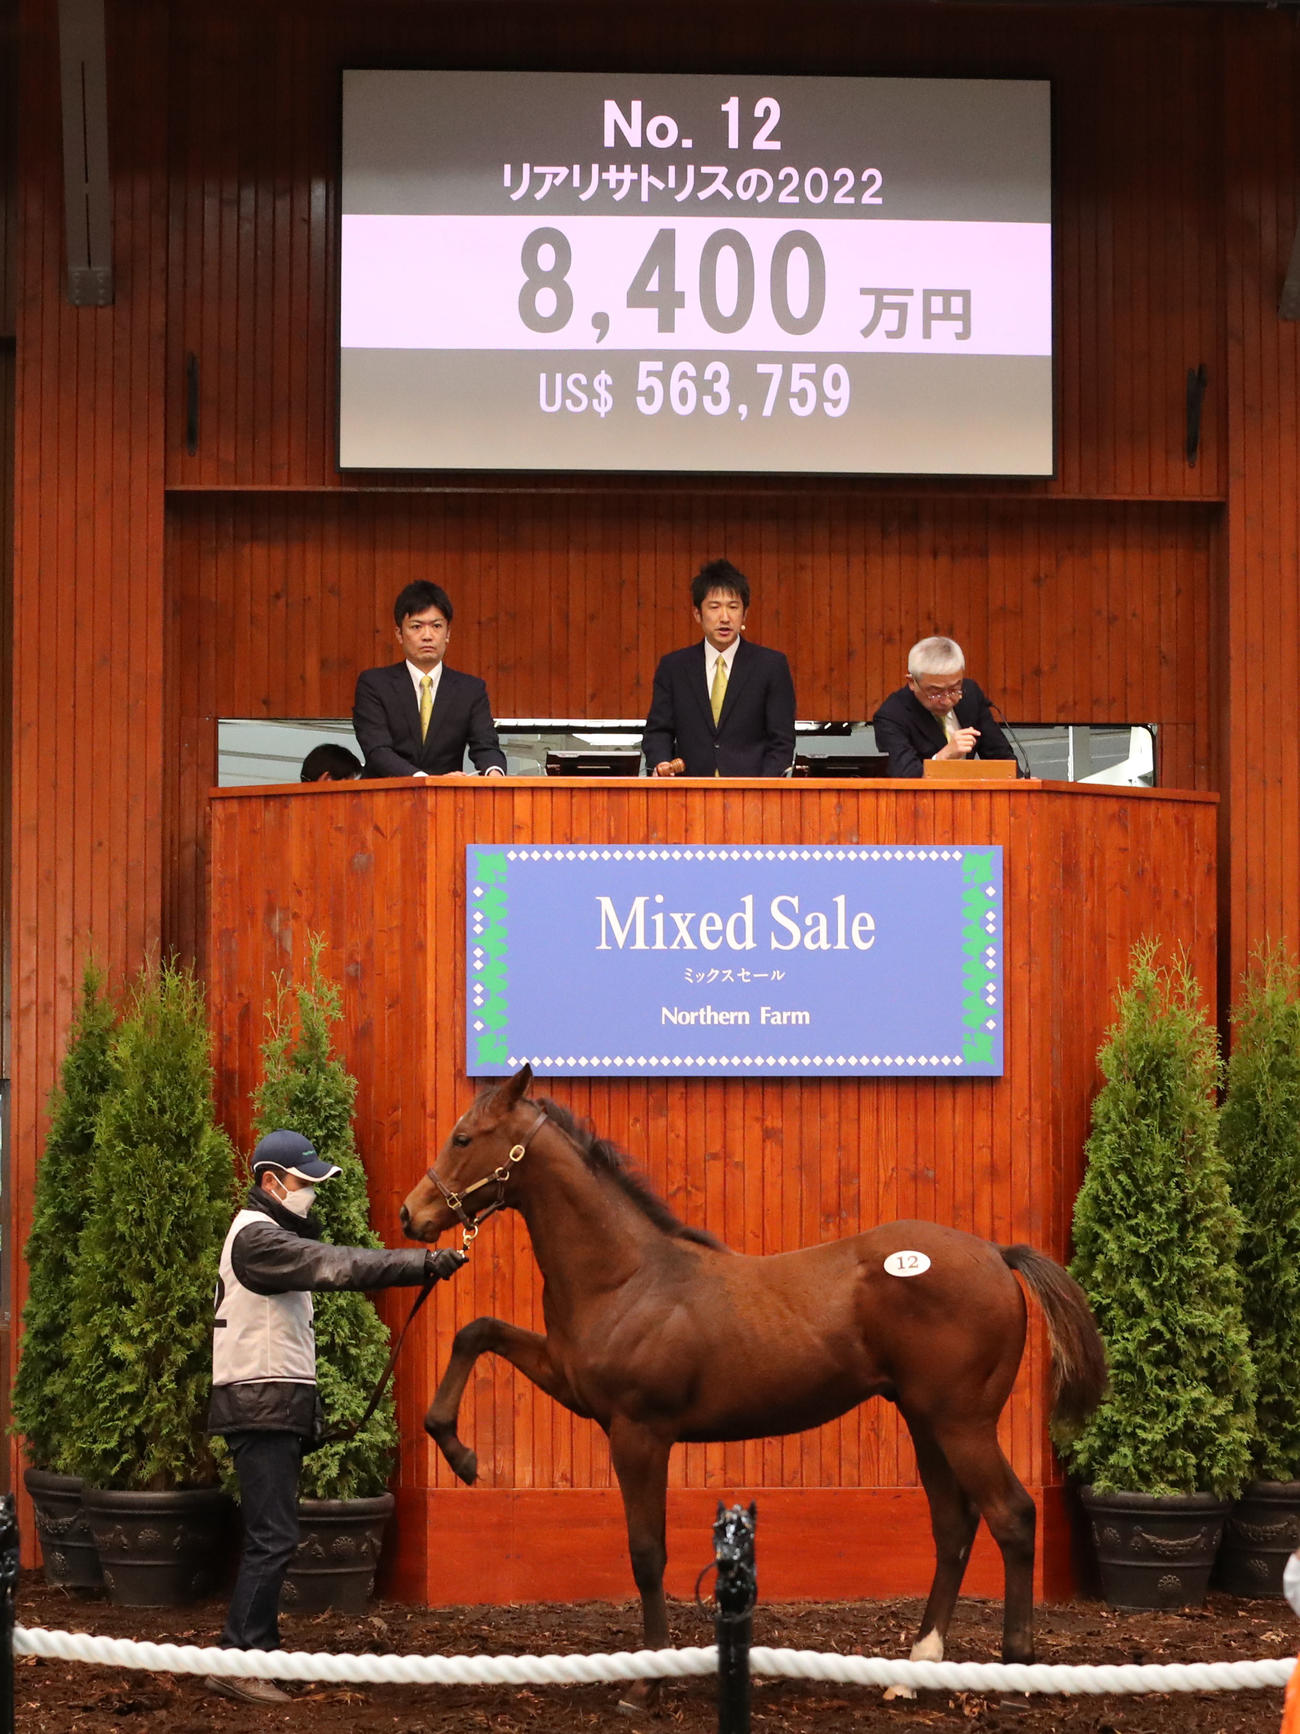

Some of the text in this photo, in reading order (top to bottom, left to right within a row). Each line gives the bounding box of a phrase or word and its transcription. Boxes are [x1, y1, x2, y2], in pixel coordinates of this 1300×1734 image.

[603, 96, 782, 151] No. 12
[503, 163, 884, 206] リアリサトリスの2022
[518, 226, 972, 343] 8,400 万円
[538, 361, 851, 420] US$ 563,759
[595, 894, 876, 951] Mixed Sale
[684, 967, 786, 984] ミックスセール
[661, 1005, 811, 1025] Northern Farm
[896, 1255, 919, 1270] 12
